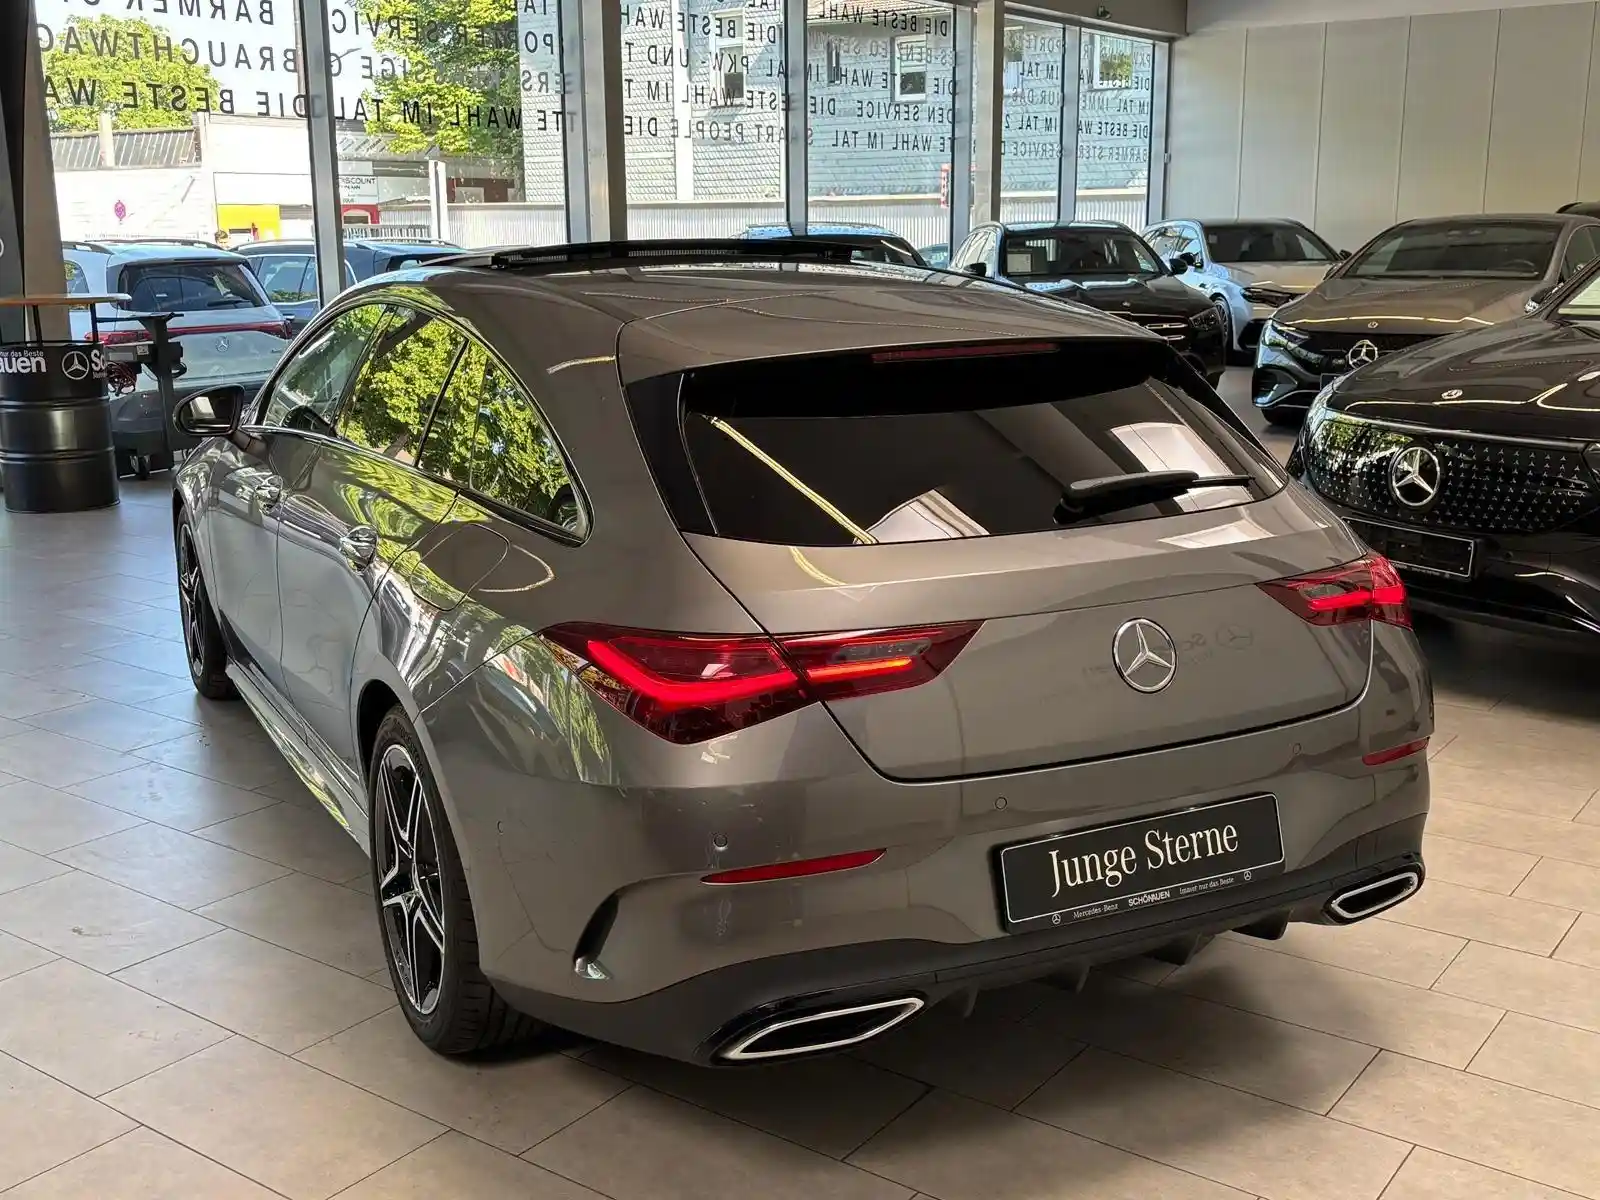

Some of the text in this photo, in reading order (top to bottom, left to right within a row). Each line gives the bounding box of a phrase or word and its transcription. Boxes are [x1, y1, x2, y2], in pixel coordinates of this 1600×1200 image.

[23, 349, 44, 357] Beste
[1048, 823, 1239, 898] Junge Sterne
